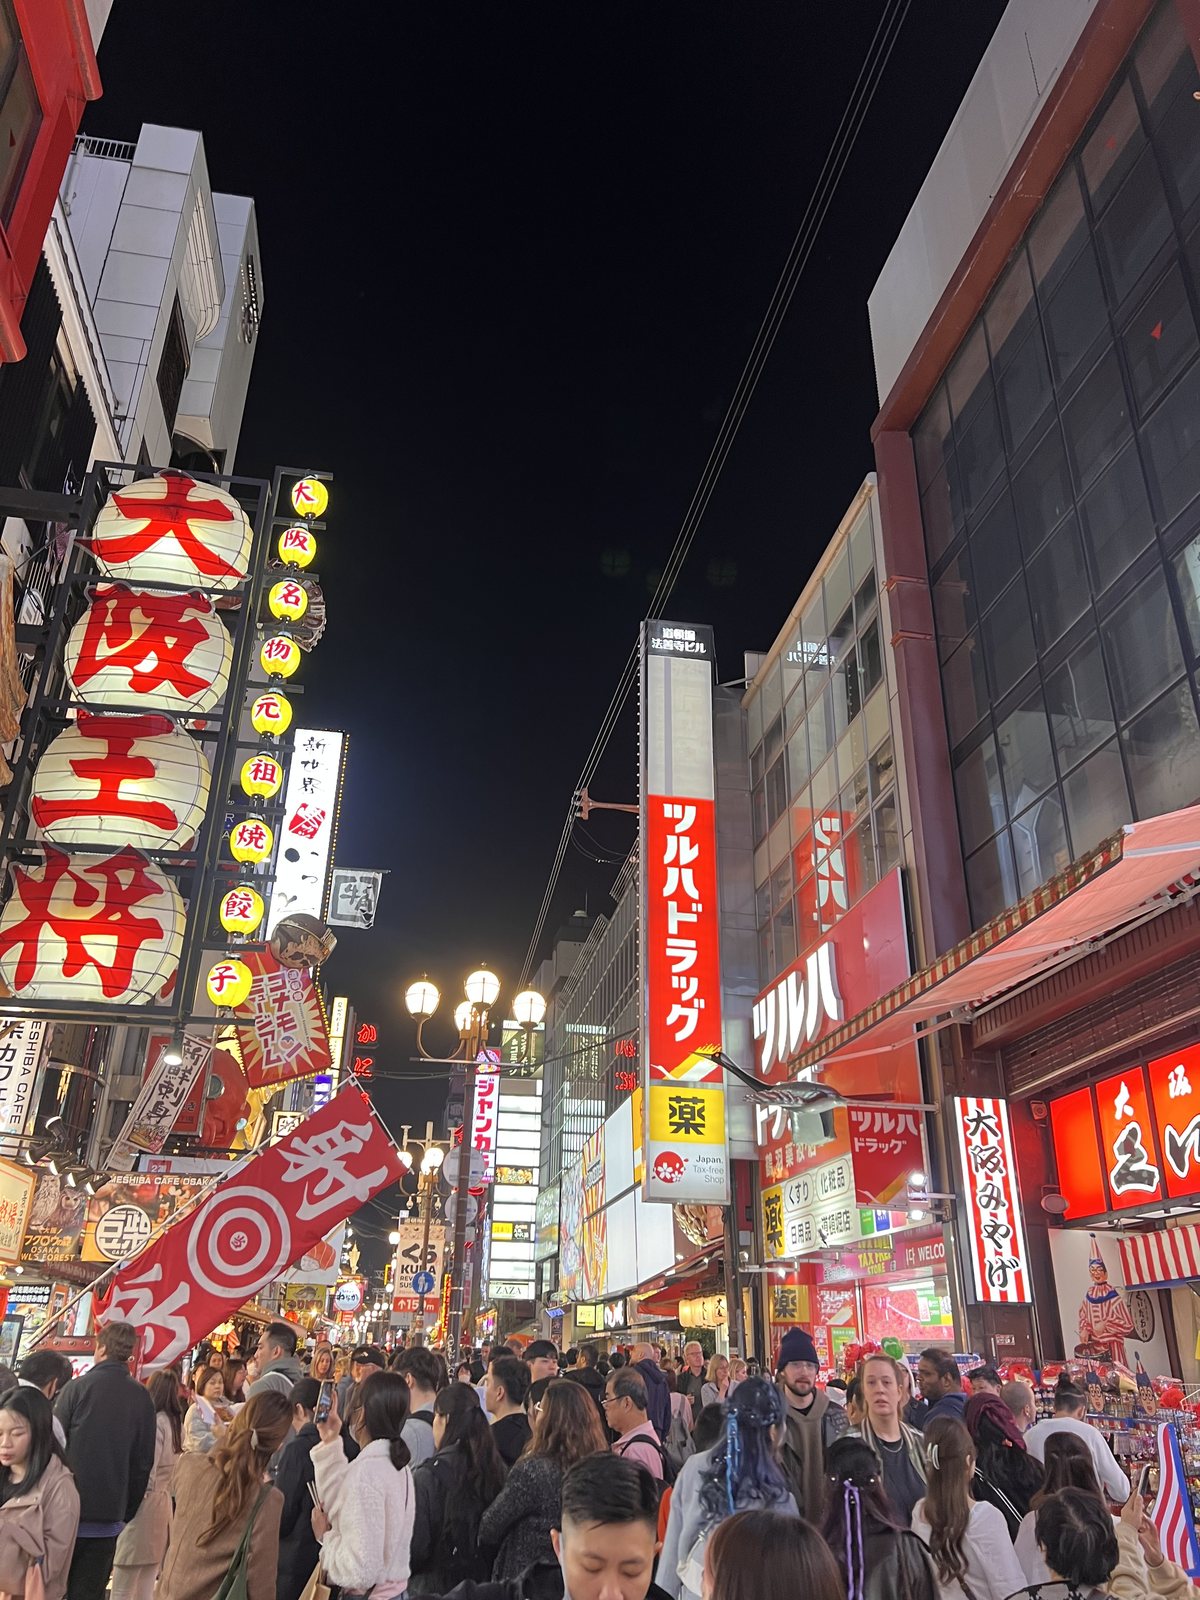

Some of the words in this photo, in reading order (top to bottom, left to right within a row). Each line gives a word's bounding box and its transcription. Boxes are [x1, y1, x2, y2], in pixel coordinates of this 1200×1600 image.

[0, 470, 253, 1000] 大阪王将
[208, 480, 318, 993] 大阪名物元祖焼餃子
[662, 803, 705, 1042] ツルハドラッグ
[267, 972, 303, 1059] コナモン
[752, 942, 838, 1075] ツルハ
[9, 1082, 28, 1124] CAFE
[669, 1096, 706, 1136] 薬
[851, 1110, 919, 1135] ツルハ
[853, 1137, 908, 1155] ドラッグ
[154, 1176, 180, 1186] CAFE
[693, 1165, 724, 1175] Tax-free
[704, 1174, 725, 1185] Shop
[820, 1166, 846, 1195] 化粧品
[788, 1181, 810, 1205] くすり
[965, 1110, 1020, 1290] 大阪みやげ
[764, 1194, 783, 1248] 薬
[791, 1221, 812, 1245] 日用品
[30, 1246, 60, 1254] OSAKA
[43, 1254, 76, 1262] FOREST
[858, 1252, 875, 1269] TAX
[401, 1264, 437, 1275] KUA
[867, 1262, 886, 1275] STORE
[495, 1286, 522, 1295] ZAZA
[774, 1288, 797, 1318] 薬
